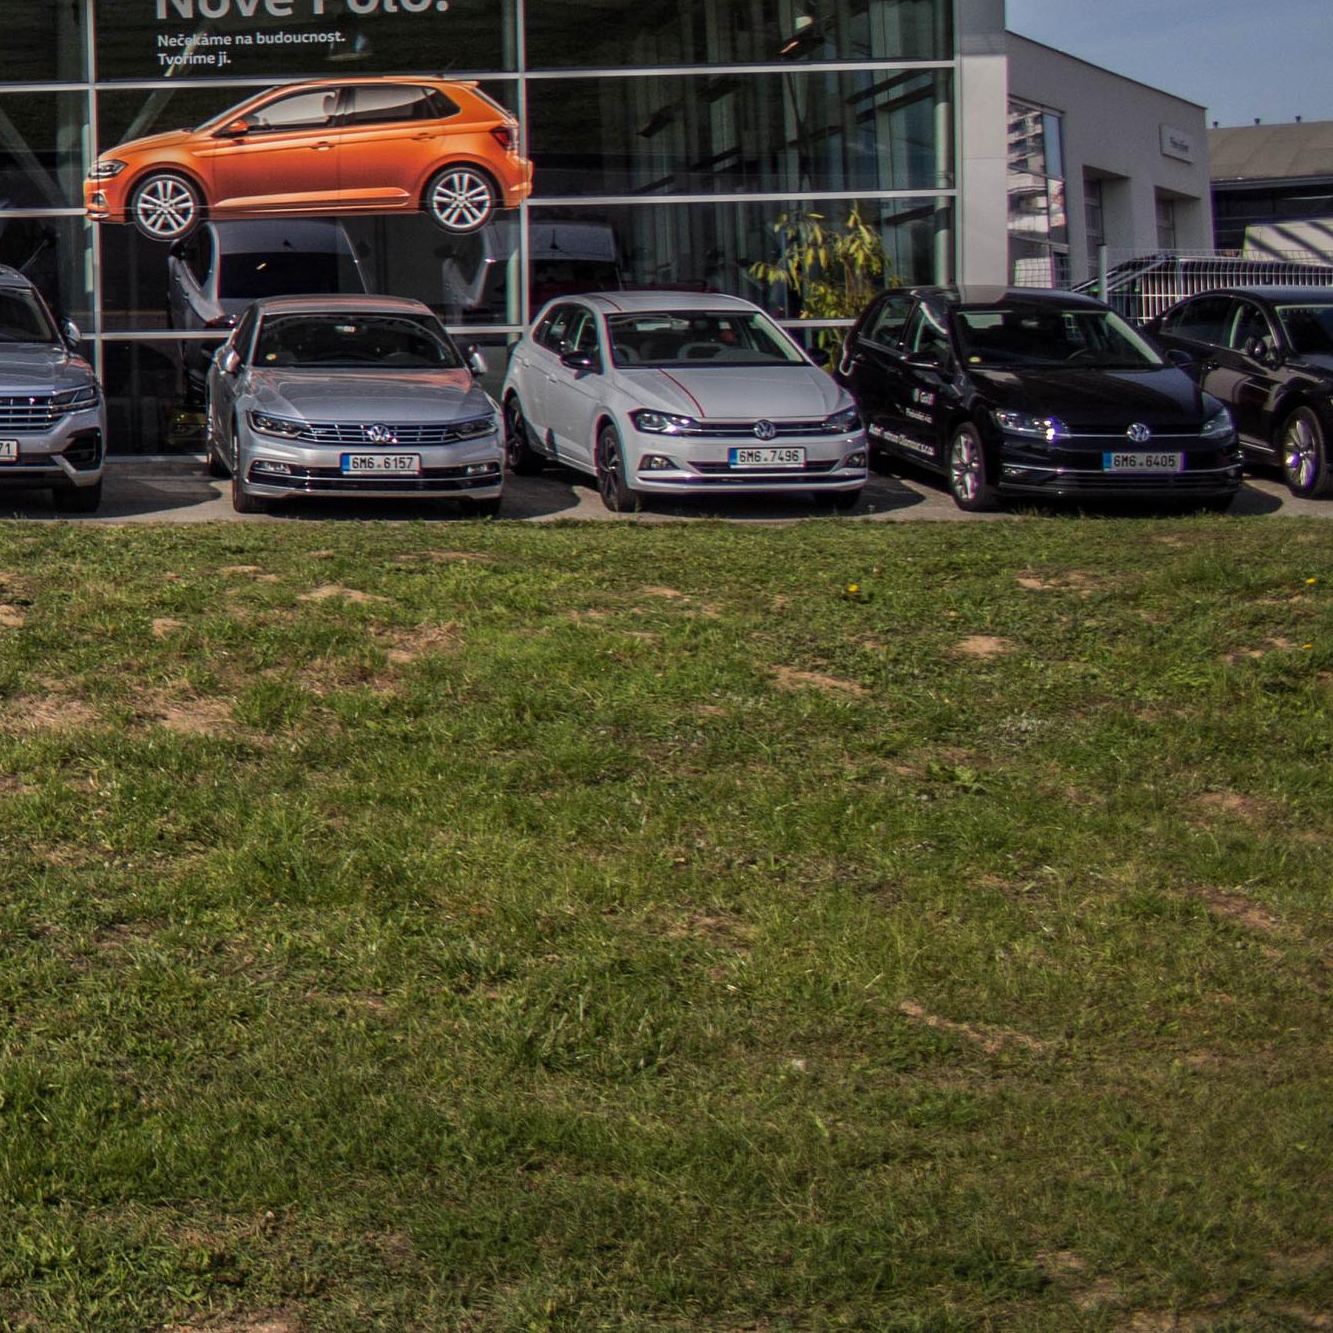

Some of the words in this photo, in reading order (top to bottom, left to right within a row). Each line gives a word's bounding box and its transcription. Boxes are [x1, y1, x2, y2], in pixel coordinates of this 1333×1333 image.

[157, 33, 232, 48] Nečekáme
[234, 34, 253, 46] na
[255, 31, 346, 45] budoucnost.
[383, 456, 414, 469] 6157
[769, 450, 800, 463] 7496
